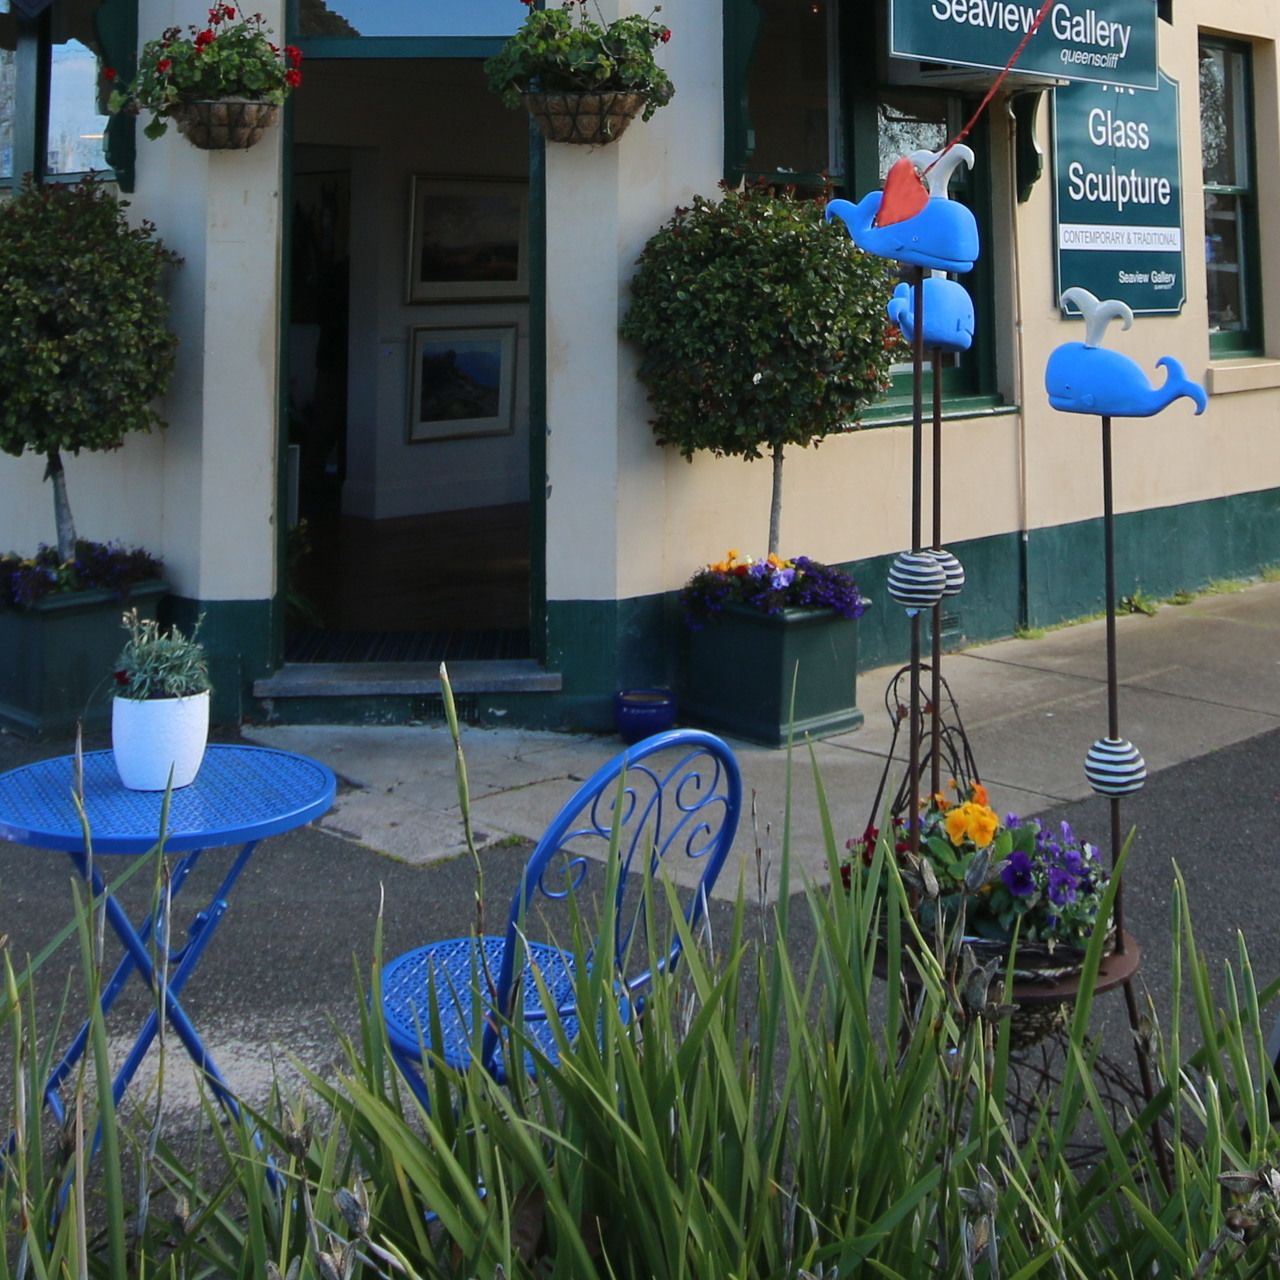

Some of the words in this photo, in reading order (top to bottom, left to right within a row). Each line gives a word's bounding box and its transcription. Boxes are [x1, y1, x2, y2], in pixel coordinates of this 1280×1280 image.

[1051, 3, 1132, 58] Gallery
[1059, 47, 1120, 69] queenscliff
[1088, 108, 1150, 151] Glass
[1068, 161, 1171, 212] Sculpture
[1063, 229, 1125, 245] CONTEMPORARY
[1133, 232, 1177, 246] TRADITIONAL
[1118, 270, 1149, 284] Seaview
[1151, 270, 1176, 286] Gallery
